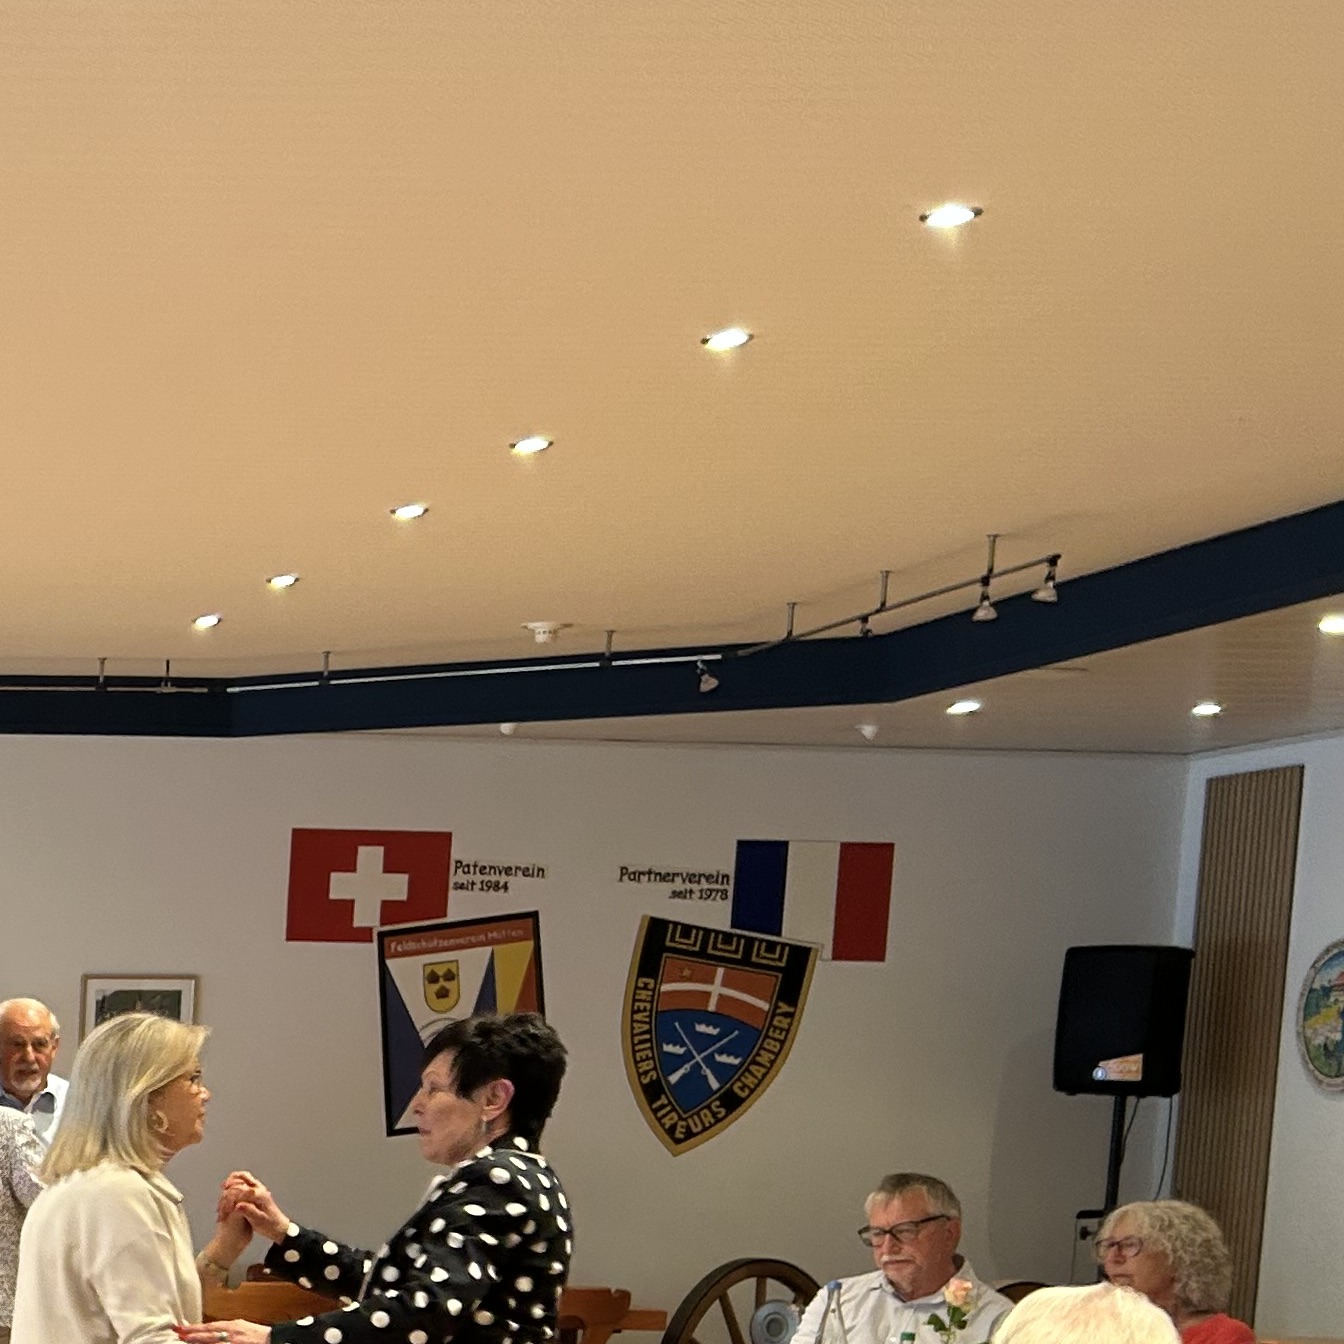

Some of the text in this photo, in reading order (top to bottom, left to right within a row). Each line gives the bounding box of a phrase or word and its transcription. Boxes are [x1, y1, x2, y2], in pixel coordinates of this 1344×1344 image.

[453, 860, 546, 879] Patenverein
[618, 865, 730, 886] Partnerverein
[452, 879, 509, 893] seit 1984
[669, 887, 729, 901] seit 1978
[631, 976, 796, 1140] CHEVALIERS TIREURS CHAMBERY
